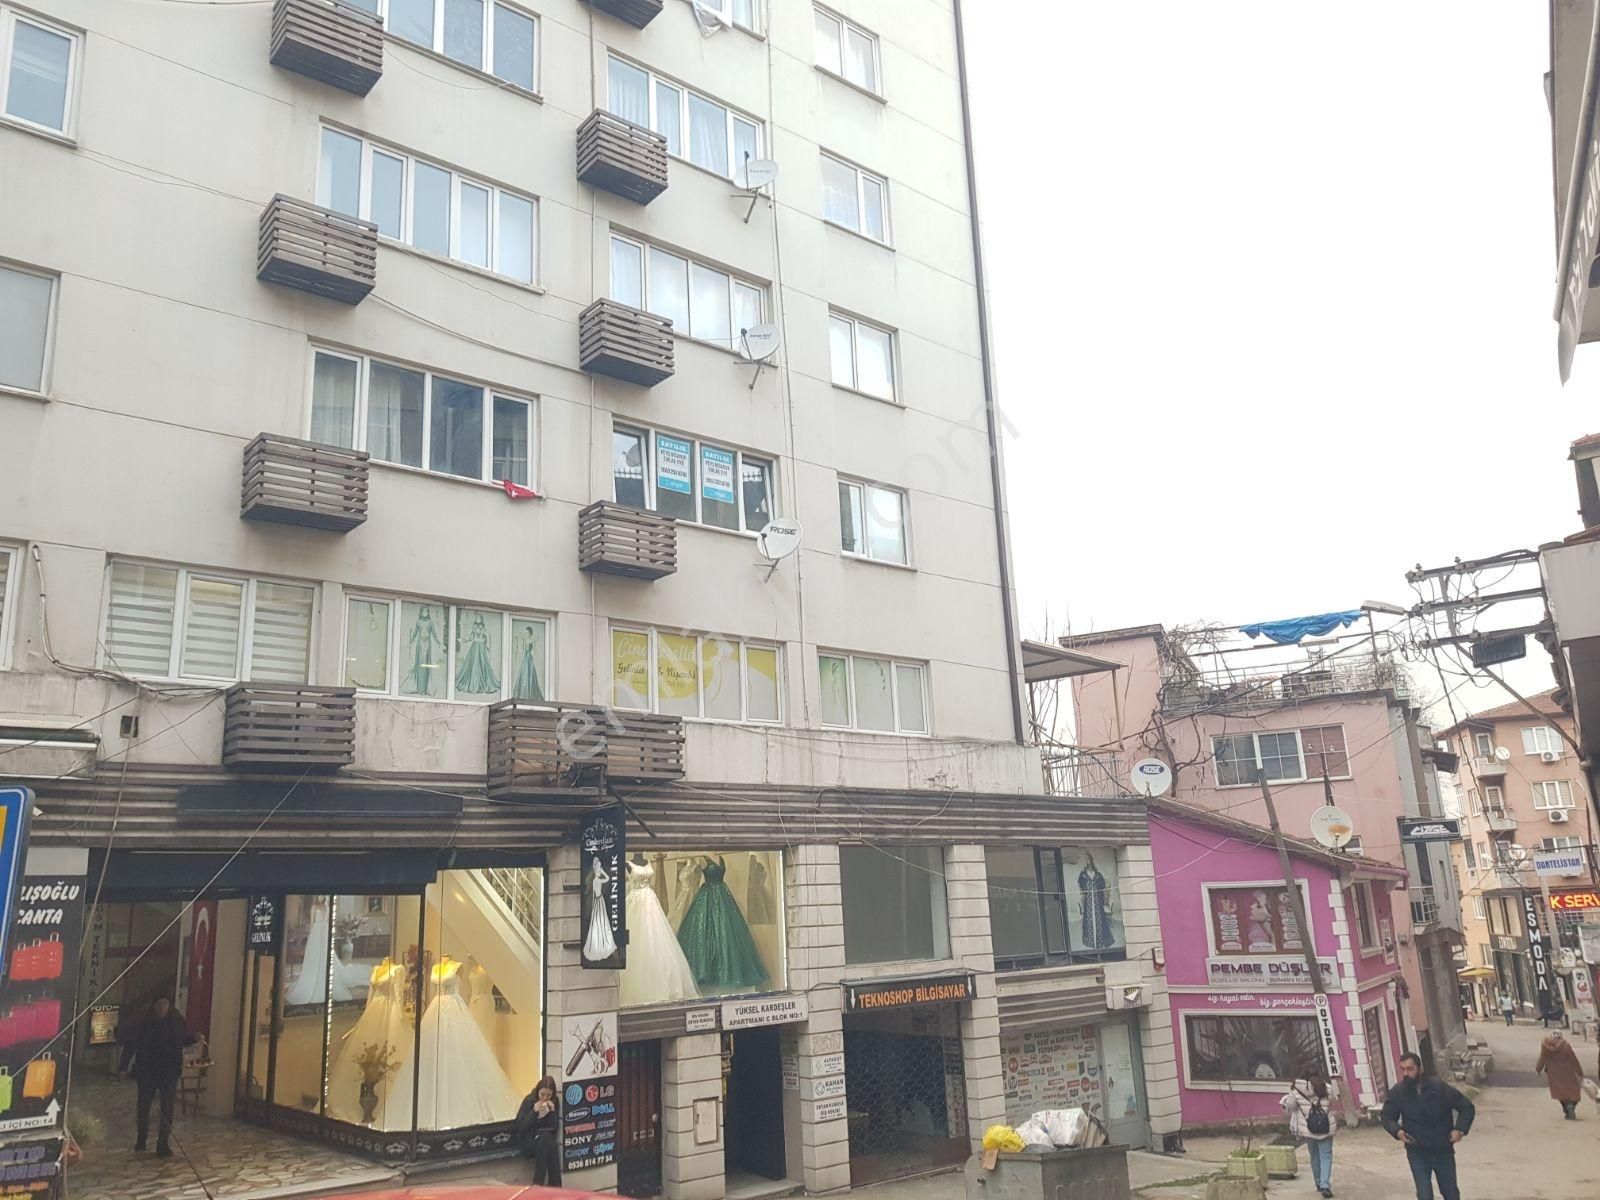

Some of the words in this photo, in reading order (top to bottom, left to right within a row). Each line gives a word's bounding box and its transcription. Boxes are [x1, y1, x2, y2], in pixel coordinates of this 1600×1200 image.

[769, 525, 797, 536] ROSE
[1143, 765, 1161, 774] ROSE
[20, 881, 80, 905] LIŞOĞLU
[1210, 963, 1263, 974] PEMBE
[1268, 961, 1333, 976] DÜŞLR
[859, 990, 914, 1009] TEKNOSHOP
[916, 983, 966, 1002] BİLGİSAYAR
[735, 1004, 760, 1016] YÜKSEL
[761, 1001, 796, 1013] KARDEŞLER
[729, 1016, 765, 1026] APARTMANI
[1320, 1008, 1339, 1075] OTOPARK
[600, 1085, 615, 1098] LG
[565, 1135, 592, 1147] SONY
